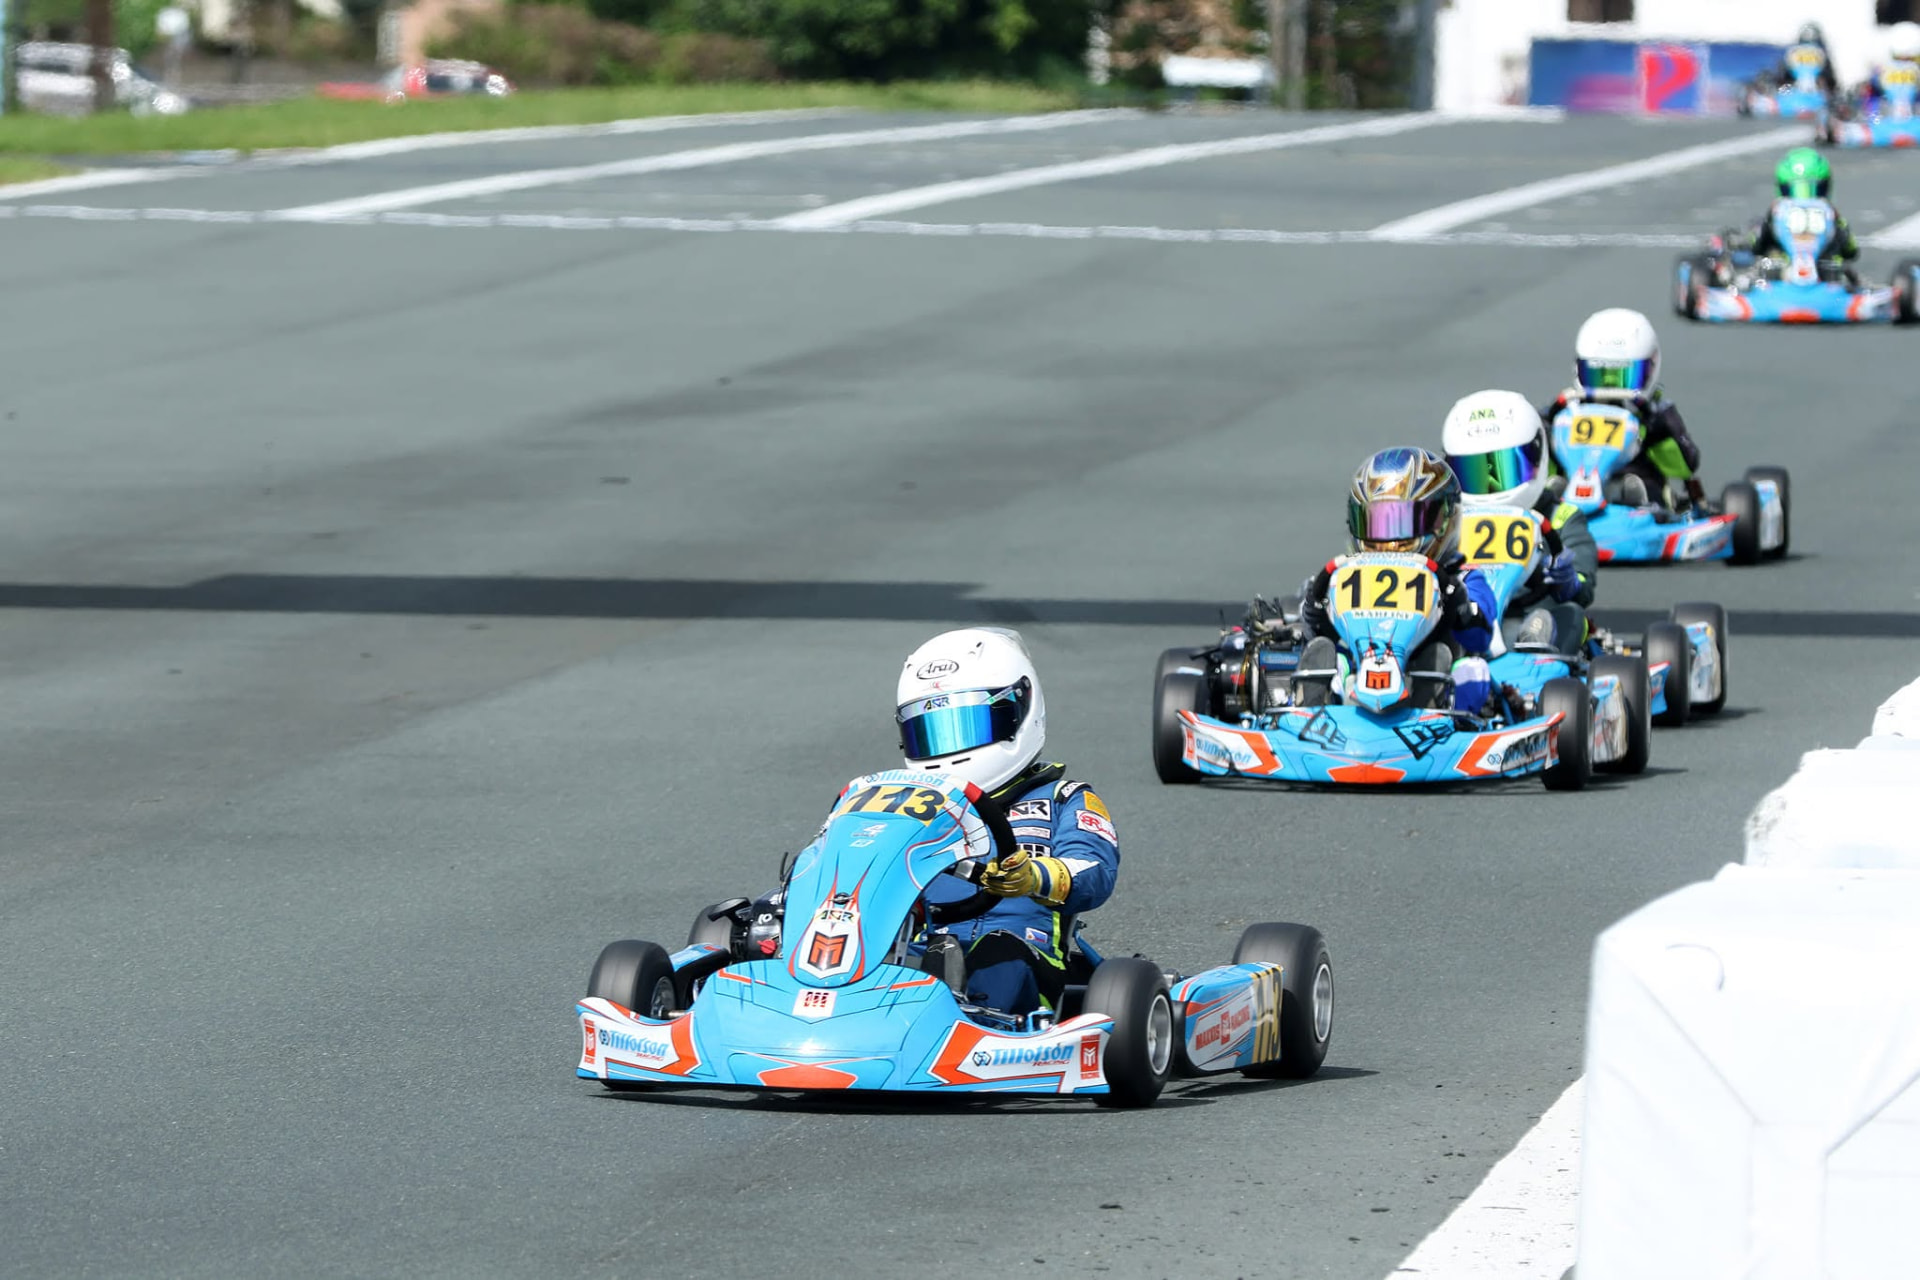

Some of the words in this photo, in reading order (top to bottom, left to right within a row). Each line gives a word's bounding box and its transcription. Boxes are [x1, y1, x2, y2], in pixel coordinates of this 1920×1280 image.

[1469, 408, 1496, 422] ANA
[1575, 417, 1622, 445] 97
[1473, 519, 1530, 560] 26
[1341, 569, 1426, 611] 121
[926, 661, 953, 674] Arai
[847, 786, 945, 821] 113
[610, 1030, 669, 1057] Tillotson
[991, 1043, 1075, 1066] Tillotson
